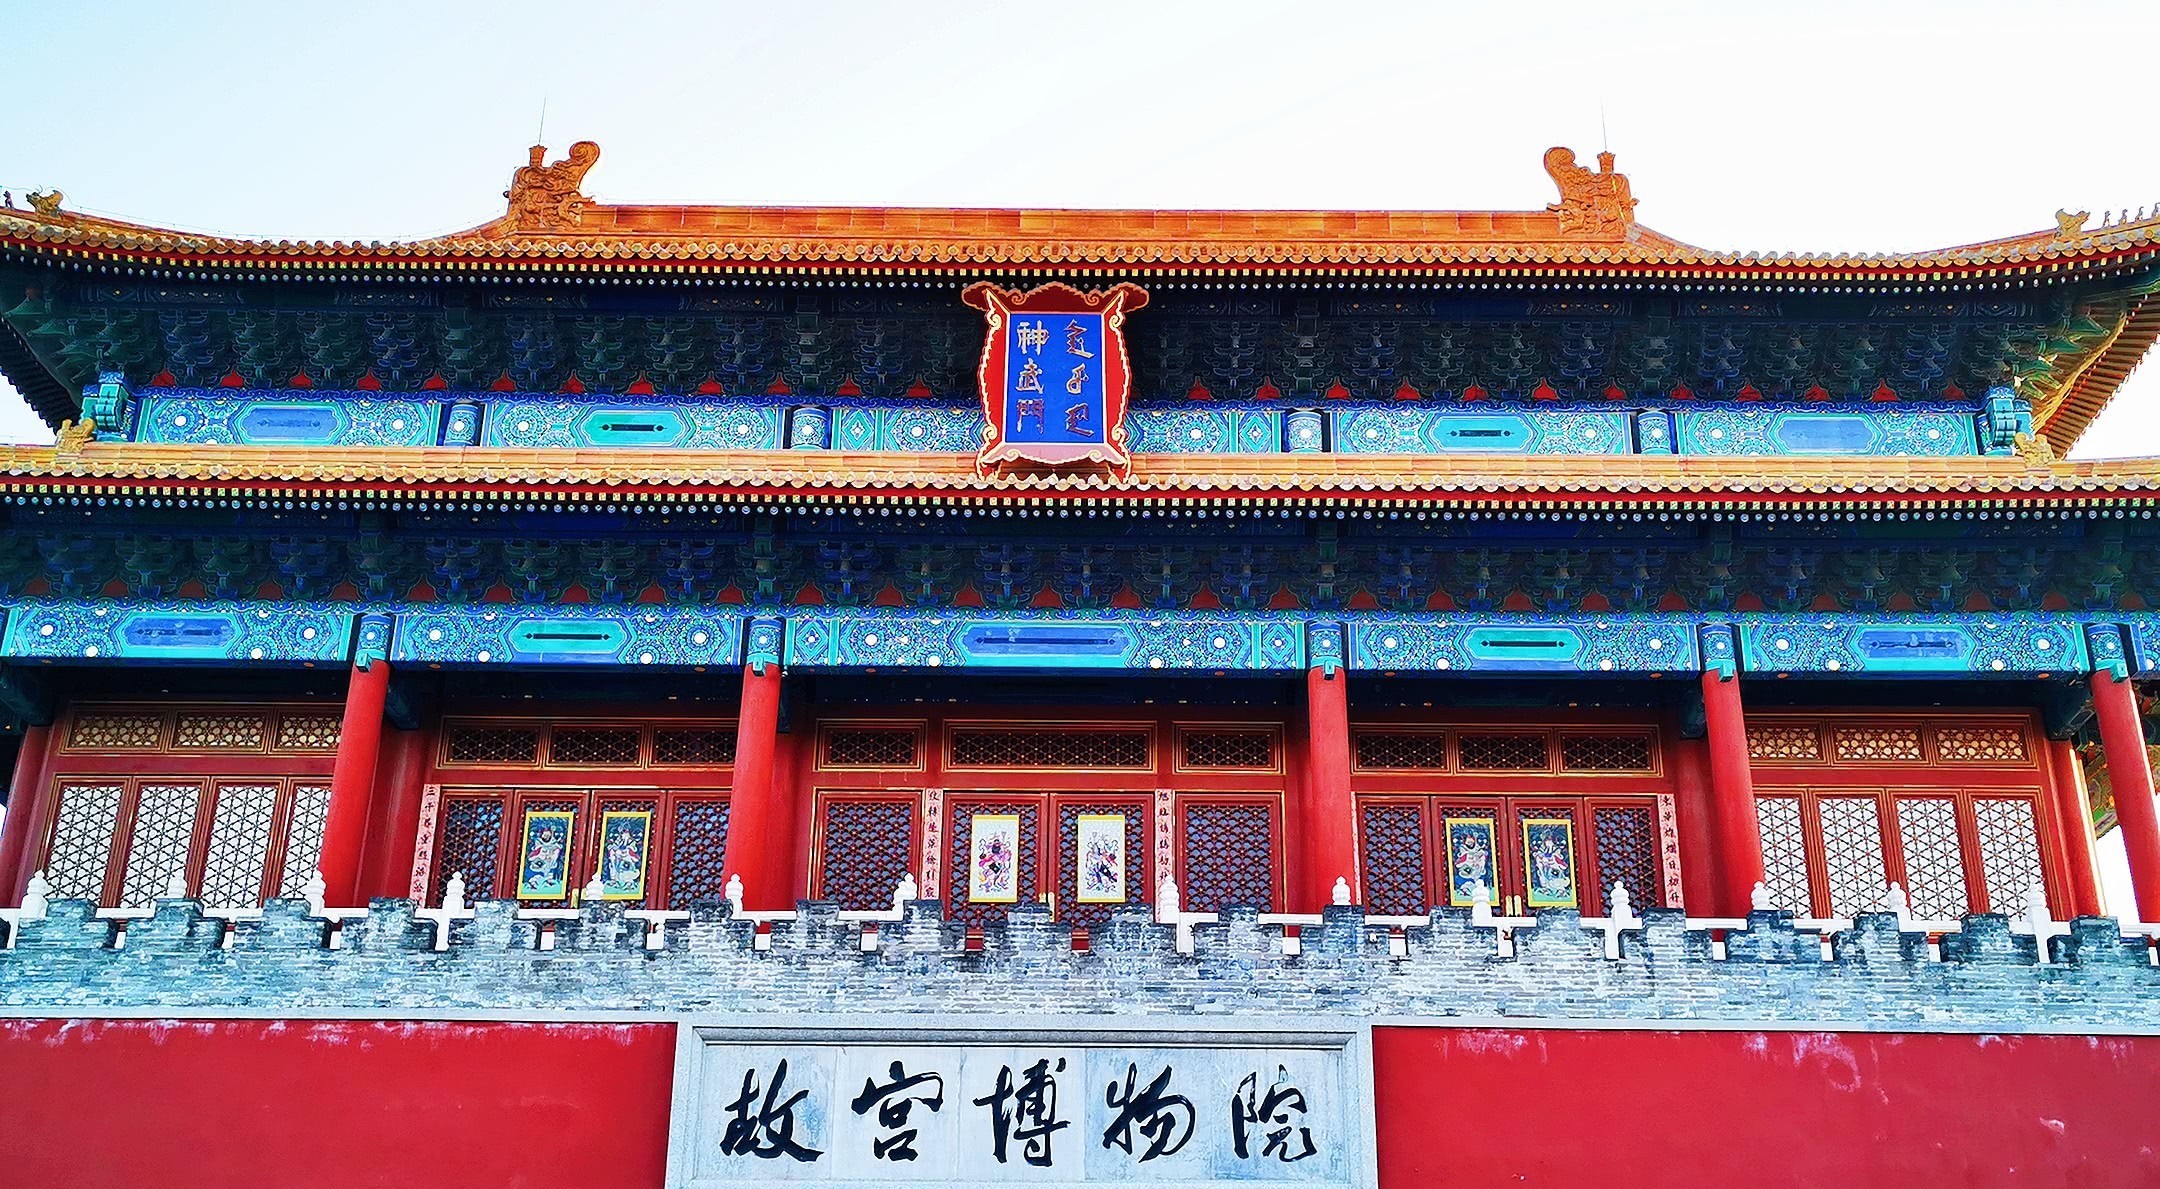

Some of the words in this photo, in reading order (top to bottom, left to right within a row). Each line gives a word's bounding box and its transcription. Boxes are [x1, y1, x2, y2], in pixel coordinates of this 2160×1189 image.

[1016, 319, 1050, 435] 神武門
[719, 1057, 1318, 1168] 故宫博物院
